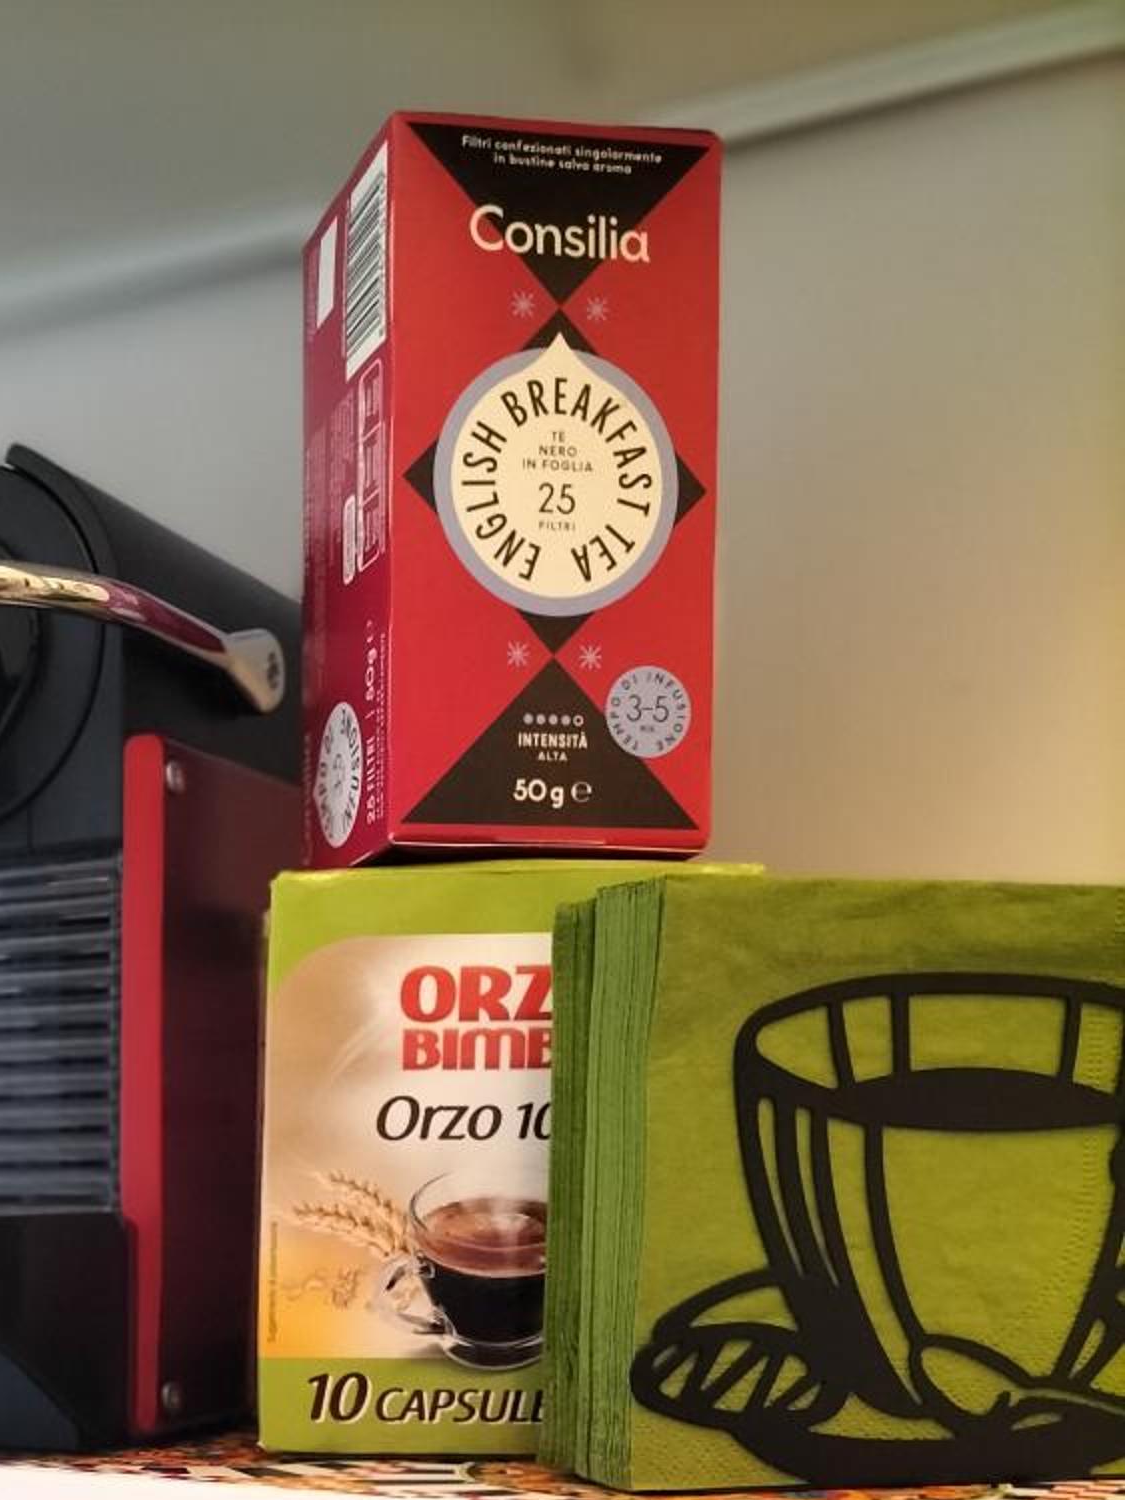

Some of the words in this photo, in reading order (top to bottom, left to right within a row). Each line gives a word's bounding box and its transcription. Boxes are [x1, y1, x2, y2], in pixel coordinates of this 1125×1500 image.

[462, 135, 491, 149] Filtri
[494, 139, 572, 156] confezionati
[575, 146, 663, 163] singolarmente
[494, 152, 506, 163] in
[509, 154, 556, 168] bustine
[559, 158, 590, 171] salva
[593, 162, 633, 175] aroma
[469, 205, 650, 263] Consilia
[501, 377, 652, 516] BREAKFAST
[522, 458, 536, 469] IN
[542, 459, 593, 472] FOGLIA
[539, 445, 577, 457] NERO
[462, 421, 542, 580] ENGLISH
[538, 482, 576, 514] 25
[538, 521, 576, 531] FILTRI
[571, 524, 635, 582] TEA
[627, 694, 669, 722] 3-5
[538, 751, 568, 762] ALTA
[400, 965, 552, 1023] ORZ
[402, 1028, 552, 1072] BIMB
[376, 1094, 502, 1142] Orzo
[518, 1101, 552, 1141] 10
[307, 1372, 369, 1425] 10
